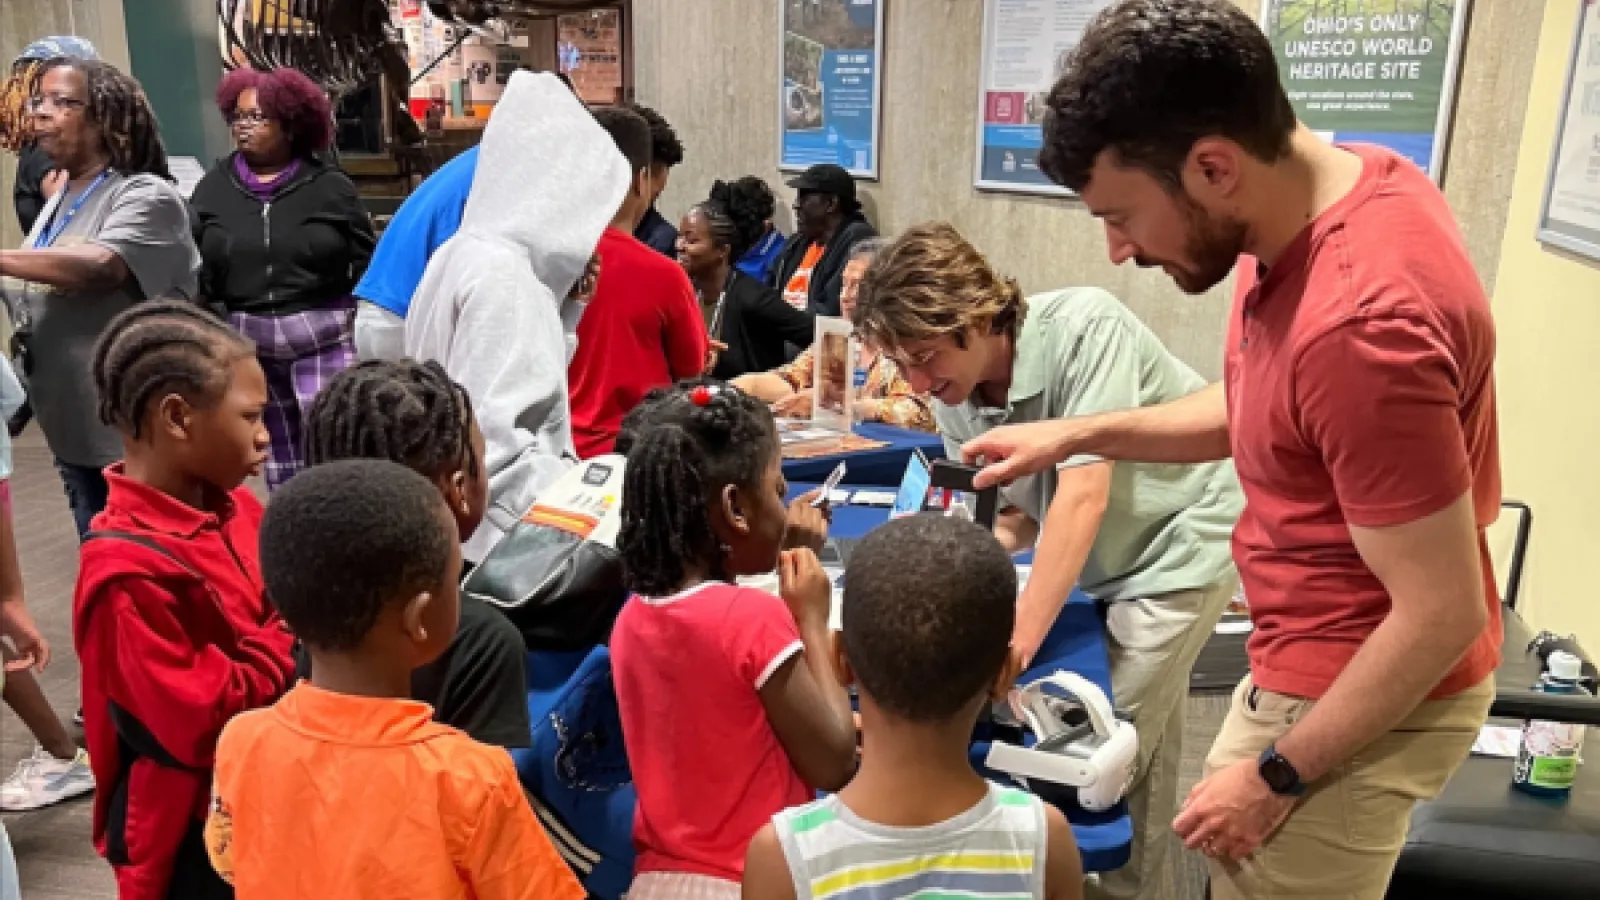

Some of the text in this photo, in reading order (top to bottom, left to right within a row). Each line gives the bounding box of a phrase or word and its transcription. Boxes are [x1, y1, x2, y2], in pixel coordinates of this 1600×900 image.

[1303, 13, 1420, 34] OHIO'S ONLY
[1284, 36, 1433, 58] UNESCO WORLD
[1289, 60, 1422, 80] HERITAGE SITE
